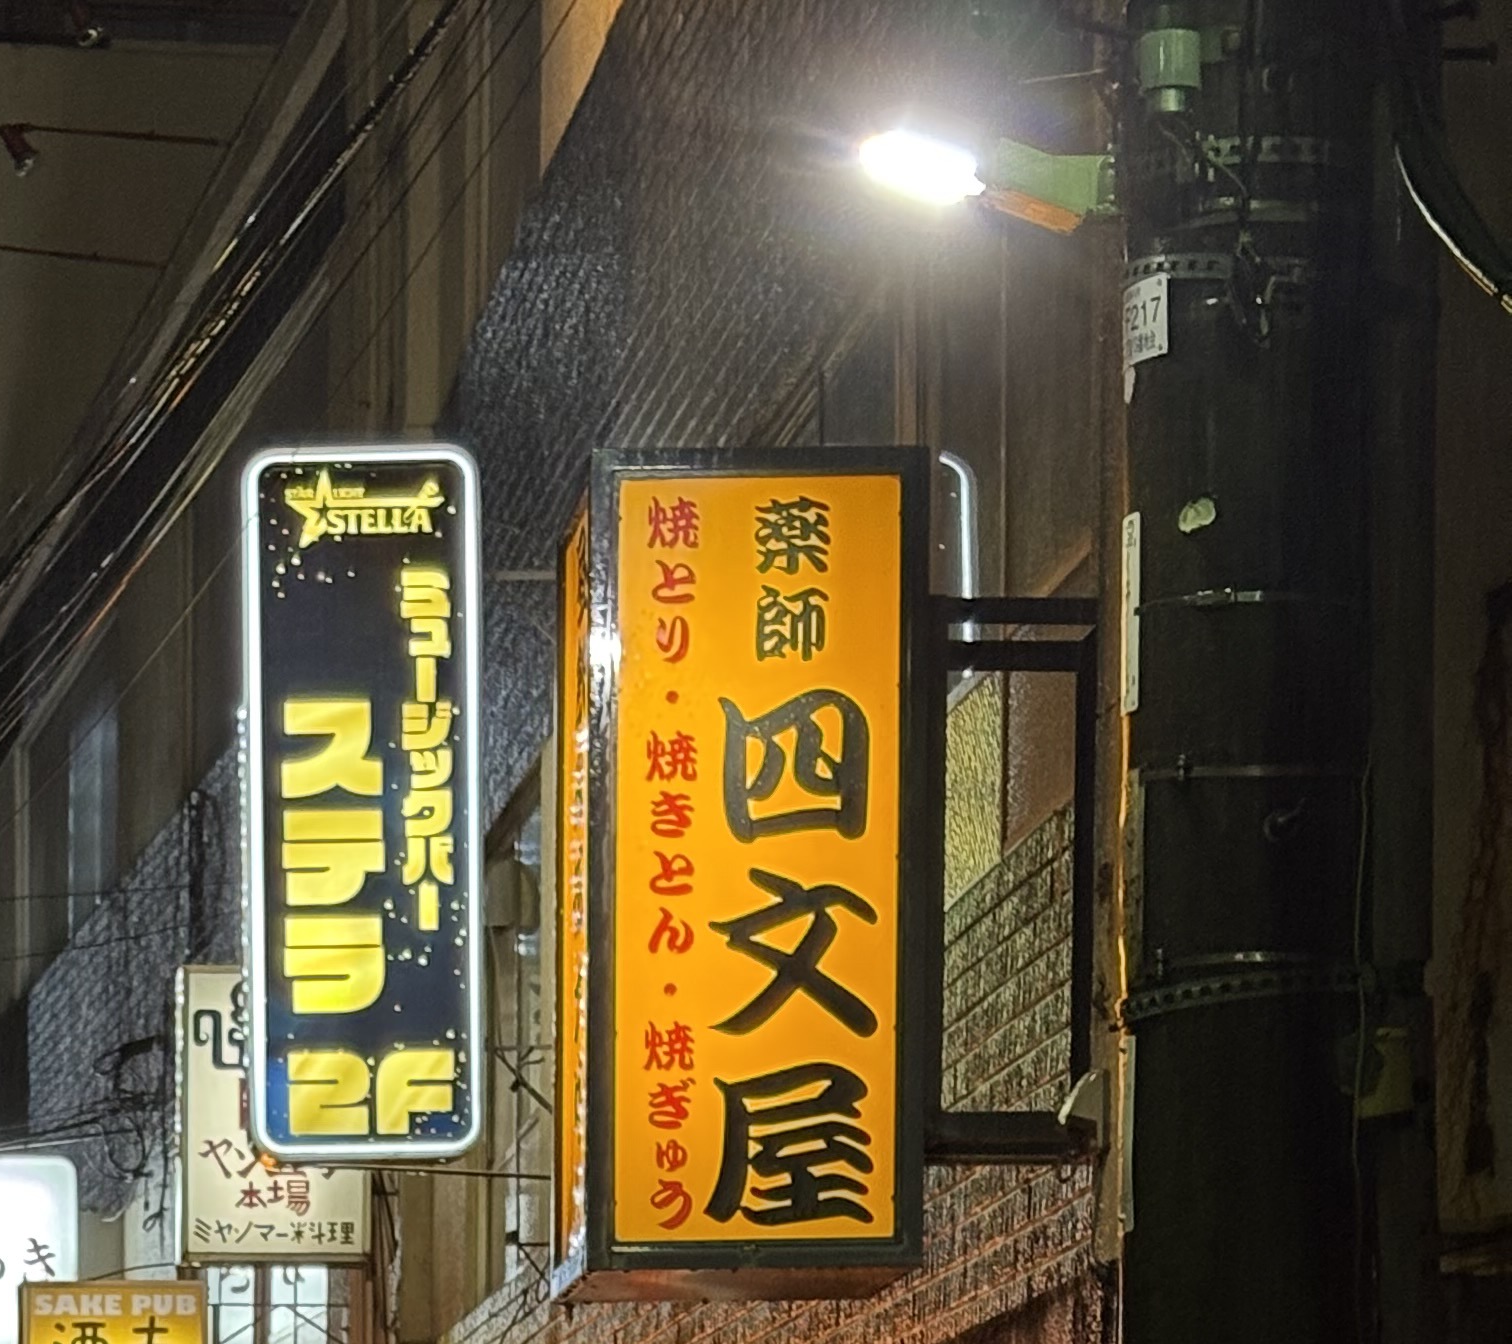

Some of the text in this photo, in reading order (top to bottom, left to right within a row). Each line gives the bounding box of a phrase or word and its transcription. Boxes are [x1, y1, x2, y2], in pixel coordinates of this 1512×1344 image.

[326, 508, 434, 535] STELLA
[400, 567, 454, 932] ミュージックバー
[281, 700, 386, 1015] ステラ
[703, 688, 879, 1227] 四文屋
[287, 1050, 455, 1136] 2F
[235, 1179, 311, 1217] 本場
[34, 1294, 197, 1316] SAKE PUB
